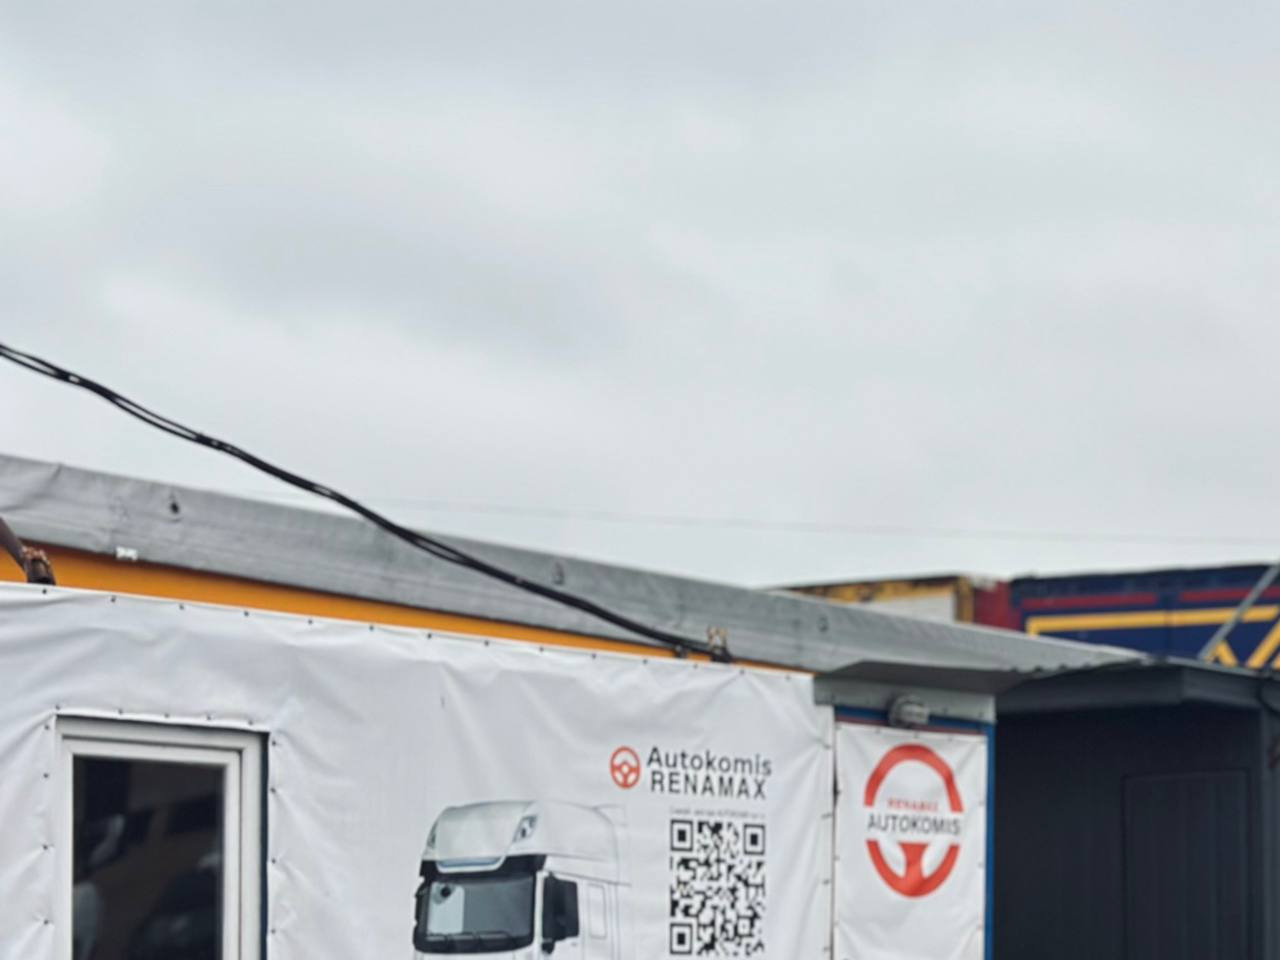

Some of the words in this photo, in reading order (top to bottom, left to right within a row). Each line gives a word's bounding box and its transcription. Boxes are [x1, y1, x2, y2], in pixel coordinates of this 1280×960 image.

[648, 746, 772, 776] Autokomis
[651, 770, 766, 799] RENAMAX
[867, 813, 961, 835] AUTOKOMIS
